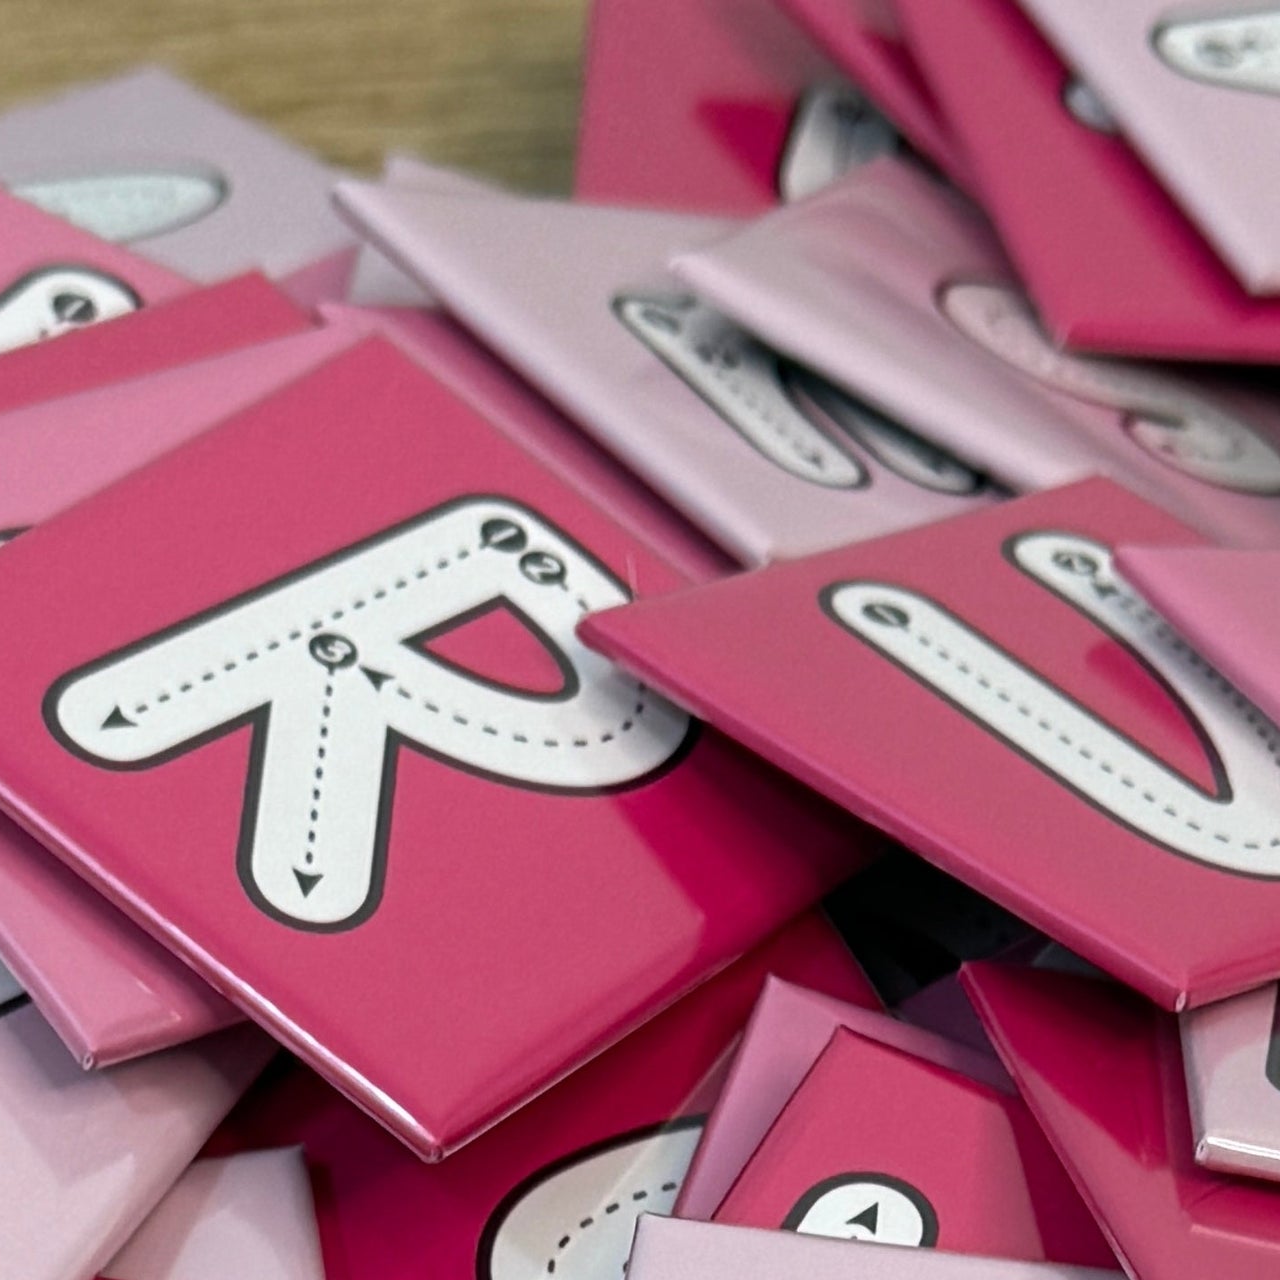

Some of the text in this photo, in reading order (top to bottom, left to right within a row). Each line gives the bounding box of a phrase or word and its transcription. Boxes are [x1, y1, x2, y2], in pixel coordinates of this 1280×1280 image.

[521, 553, 564, 583] 2
[312, 636, 356, 666] 3
[45, 494, 705, 930] R
